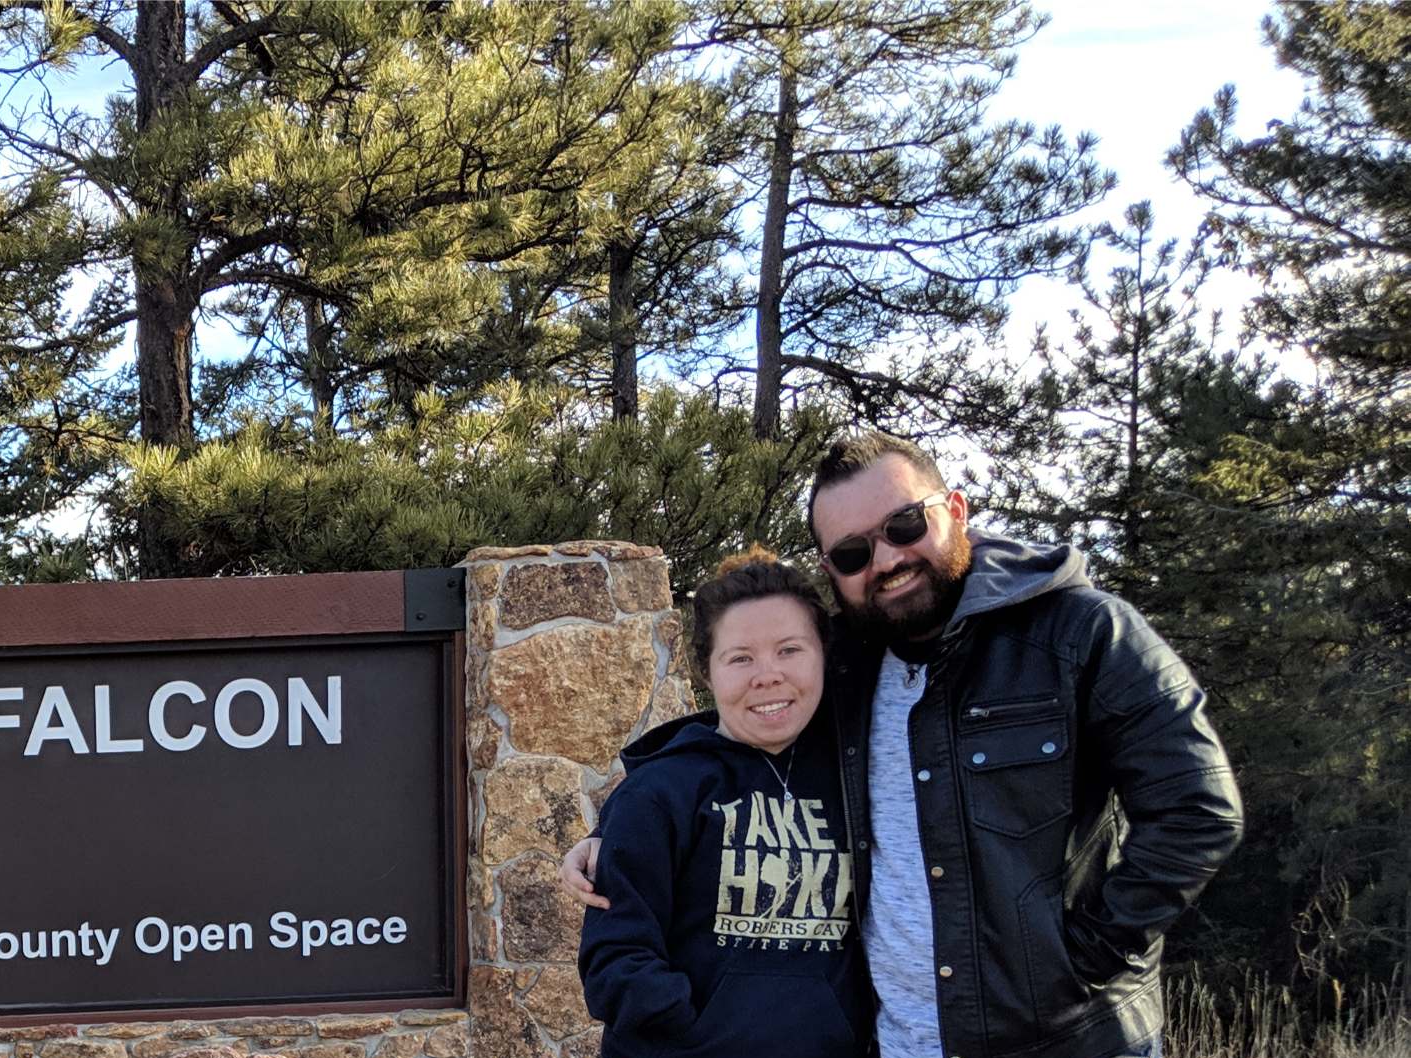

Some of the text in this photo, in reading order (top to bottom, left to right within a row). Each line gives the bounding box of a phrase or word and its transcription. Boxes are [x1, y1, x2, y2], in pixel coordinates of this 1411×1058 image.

[712, 791, 836, 850] TAKE
[134, 916, 253, 961] Open
[269, 911, 408, 956] Space
[812, 923, 849, 938] CAV
